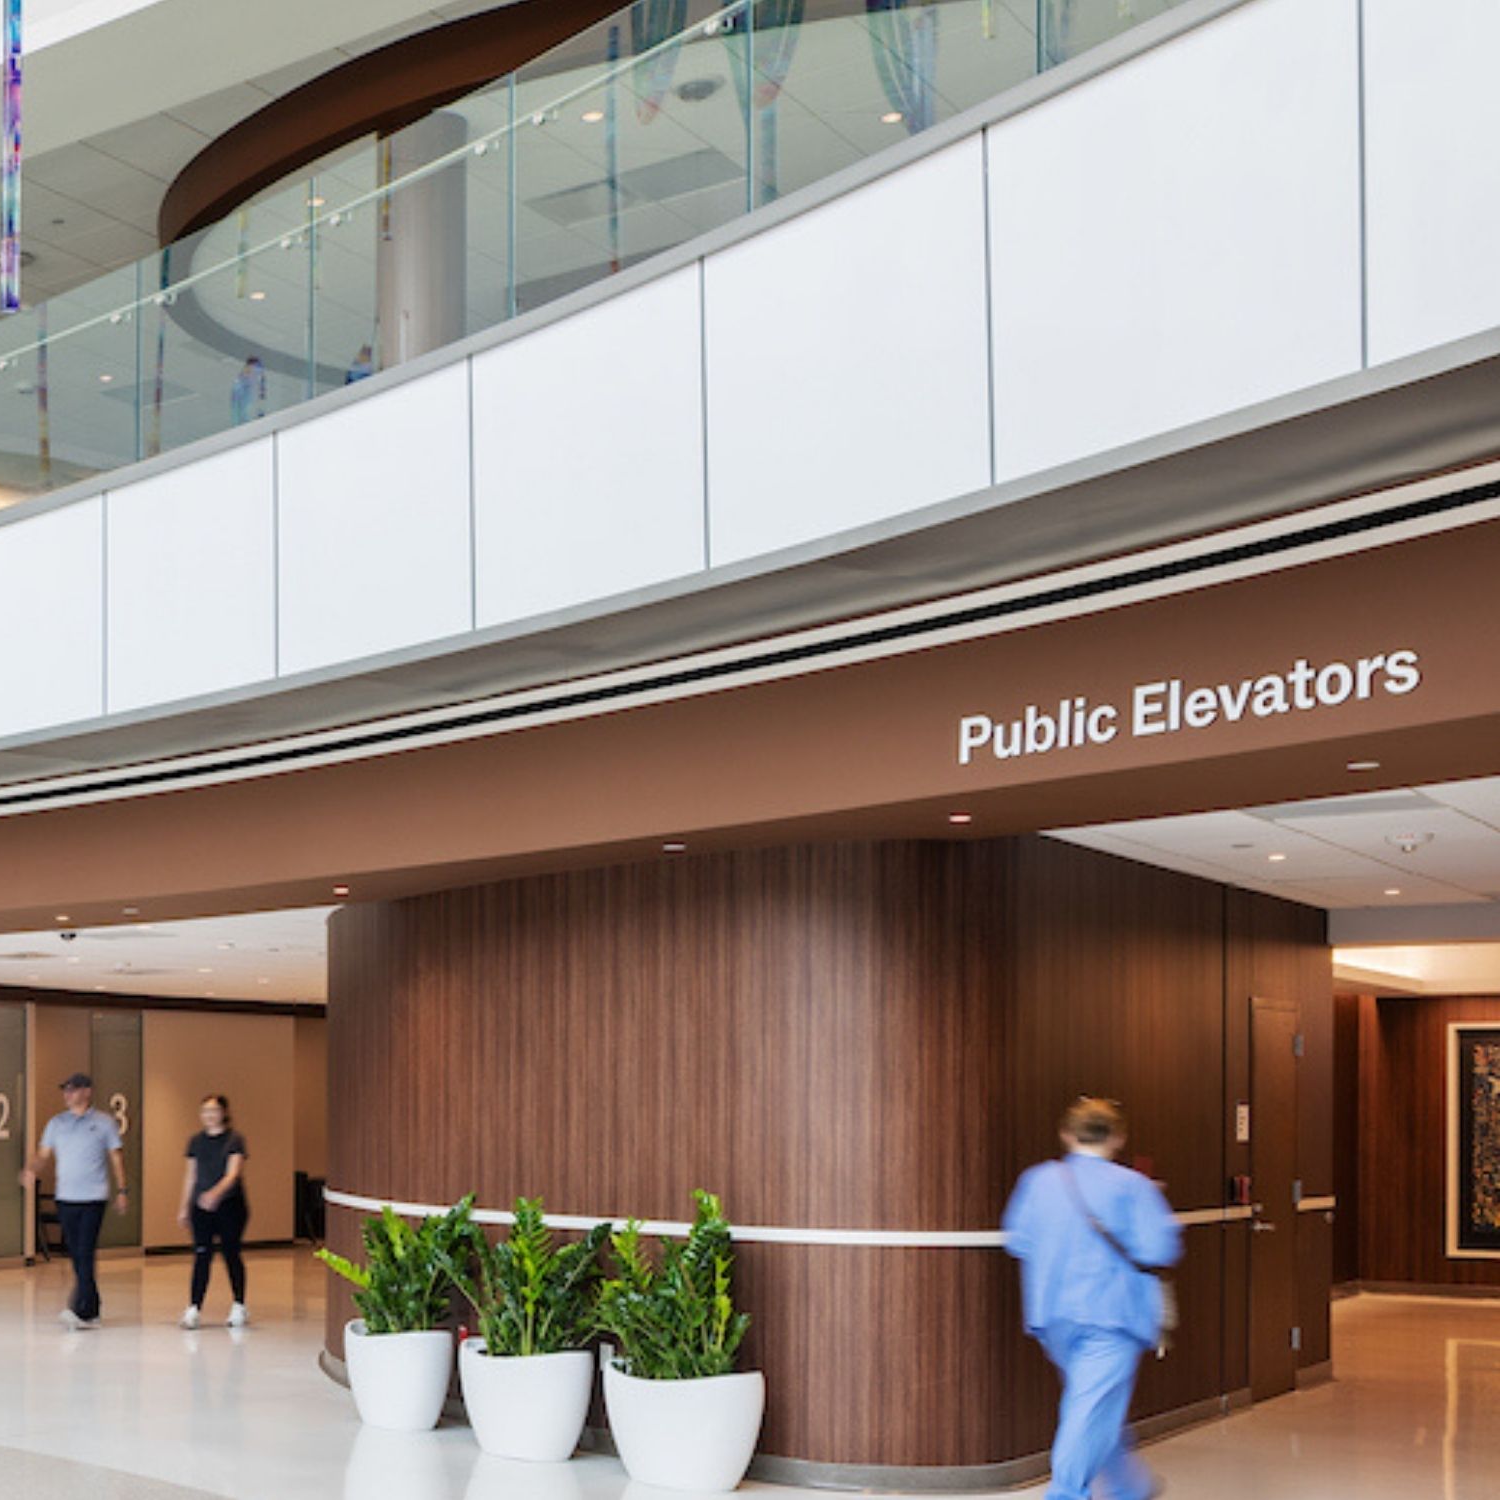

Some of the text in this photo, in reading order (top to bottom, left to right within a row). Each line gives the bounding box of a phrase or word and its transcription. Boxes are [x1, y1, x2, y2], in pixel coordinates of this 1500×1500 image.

[958, 649, 1421, 765] Public Elevators
[109, 1092, 129, 1136] 3
